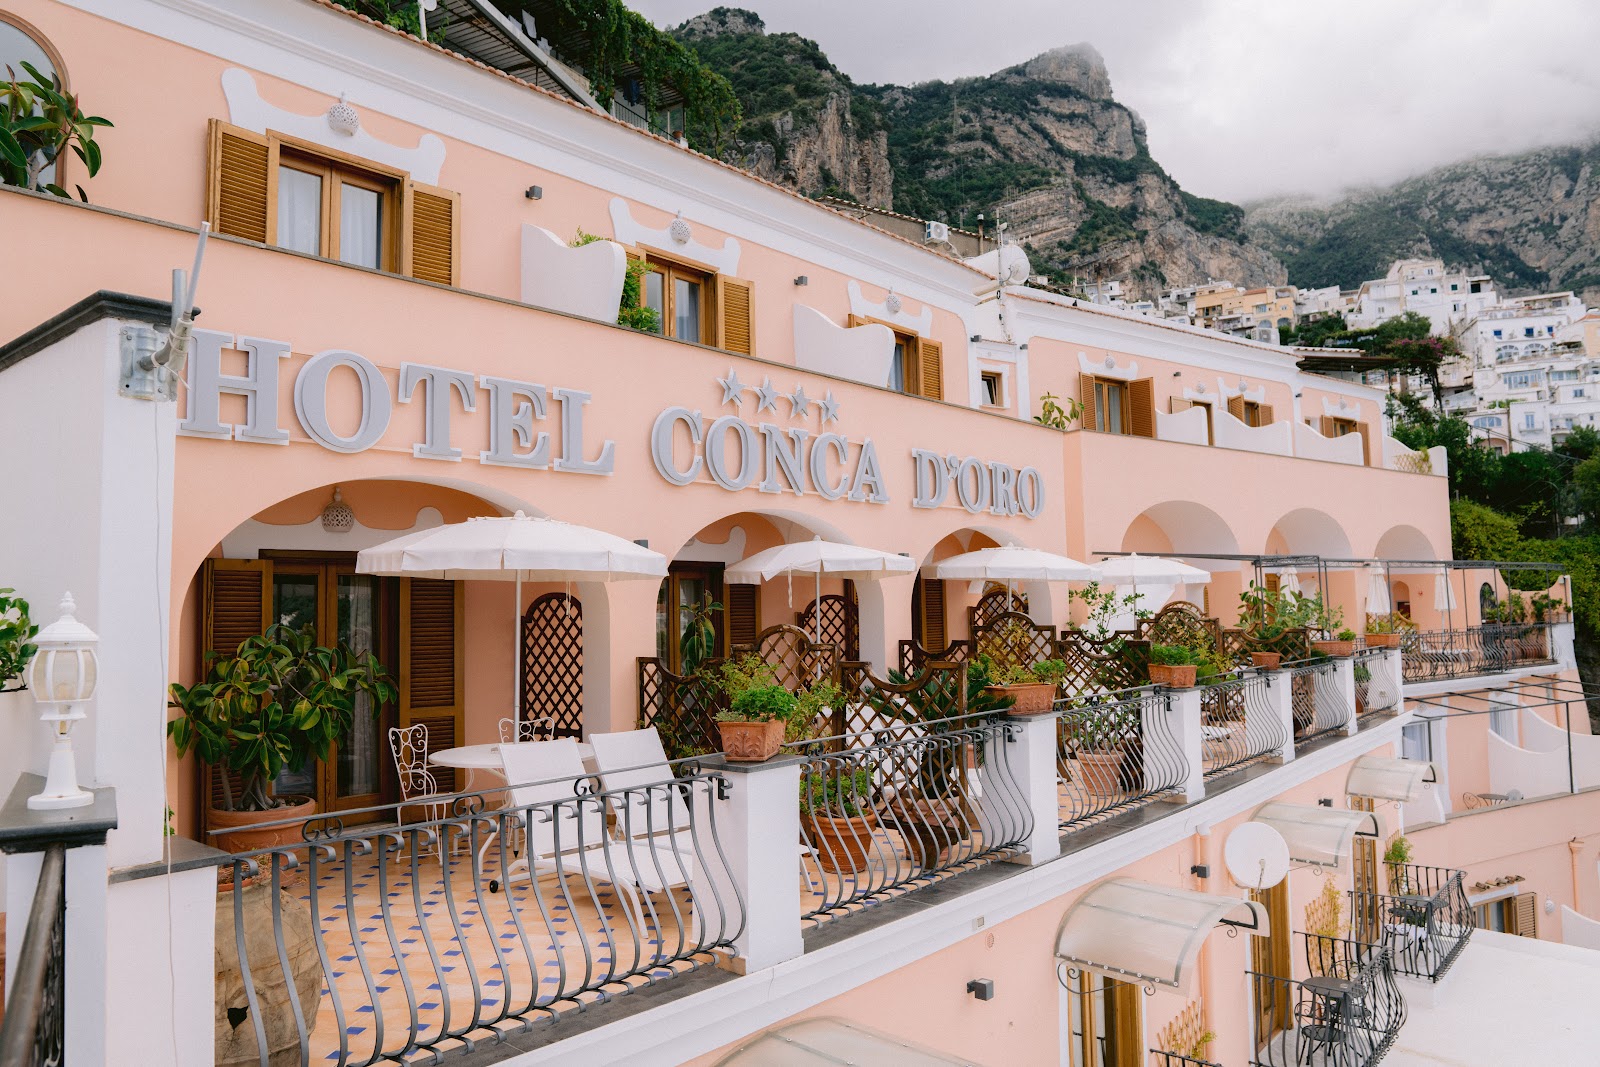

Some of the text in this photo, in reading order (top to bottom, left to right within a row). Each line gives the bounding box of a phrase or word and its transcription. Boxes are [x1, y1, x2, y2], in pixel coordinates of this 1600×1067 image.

[177, 328, 1046, 519] HOTEL CONCA D'ORO
